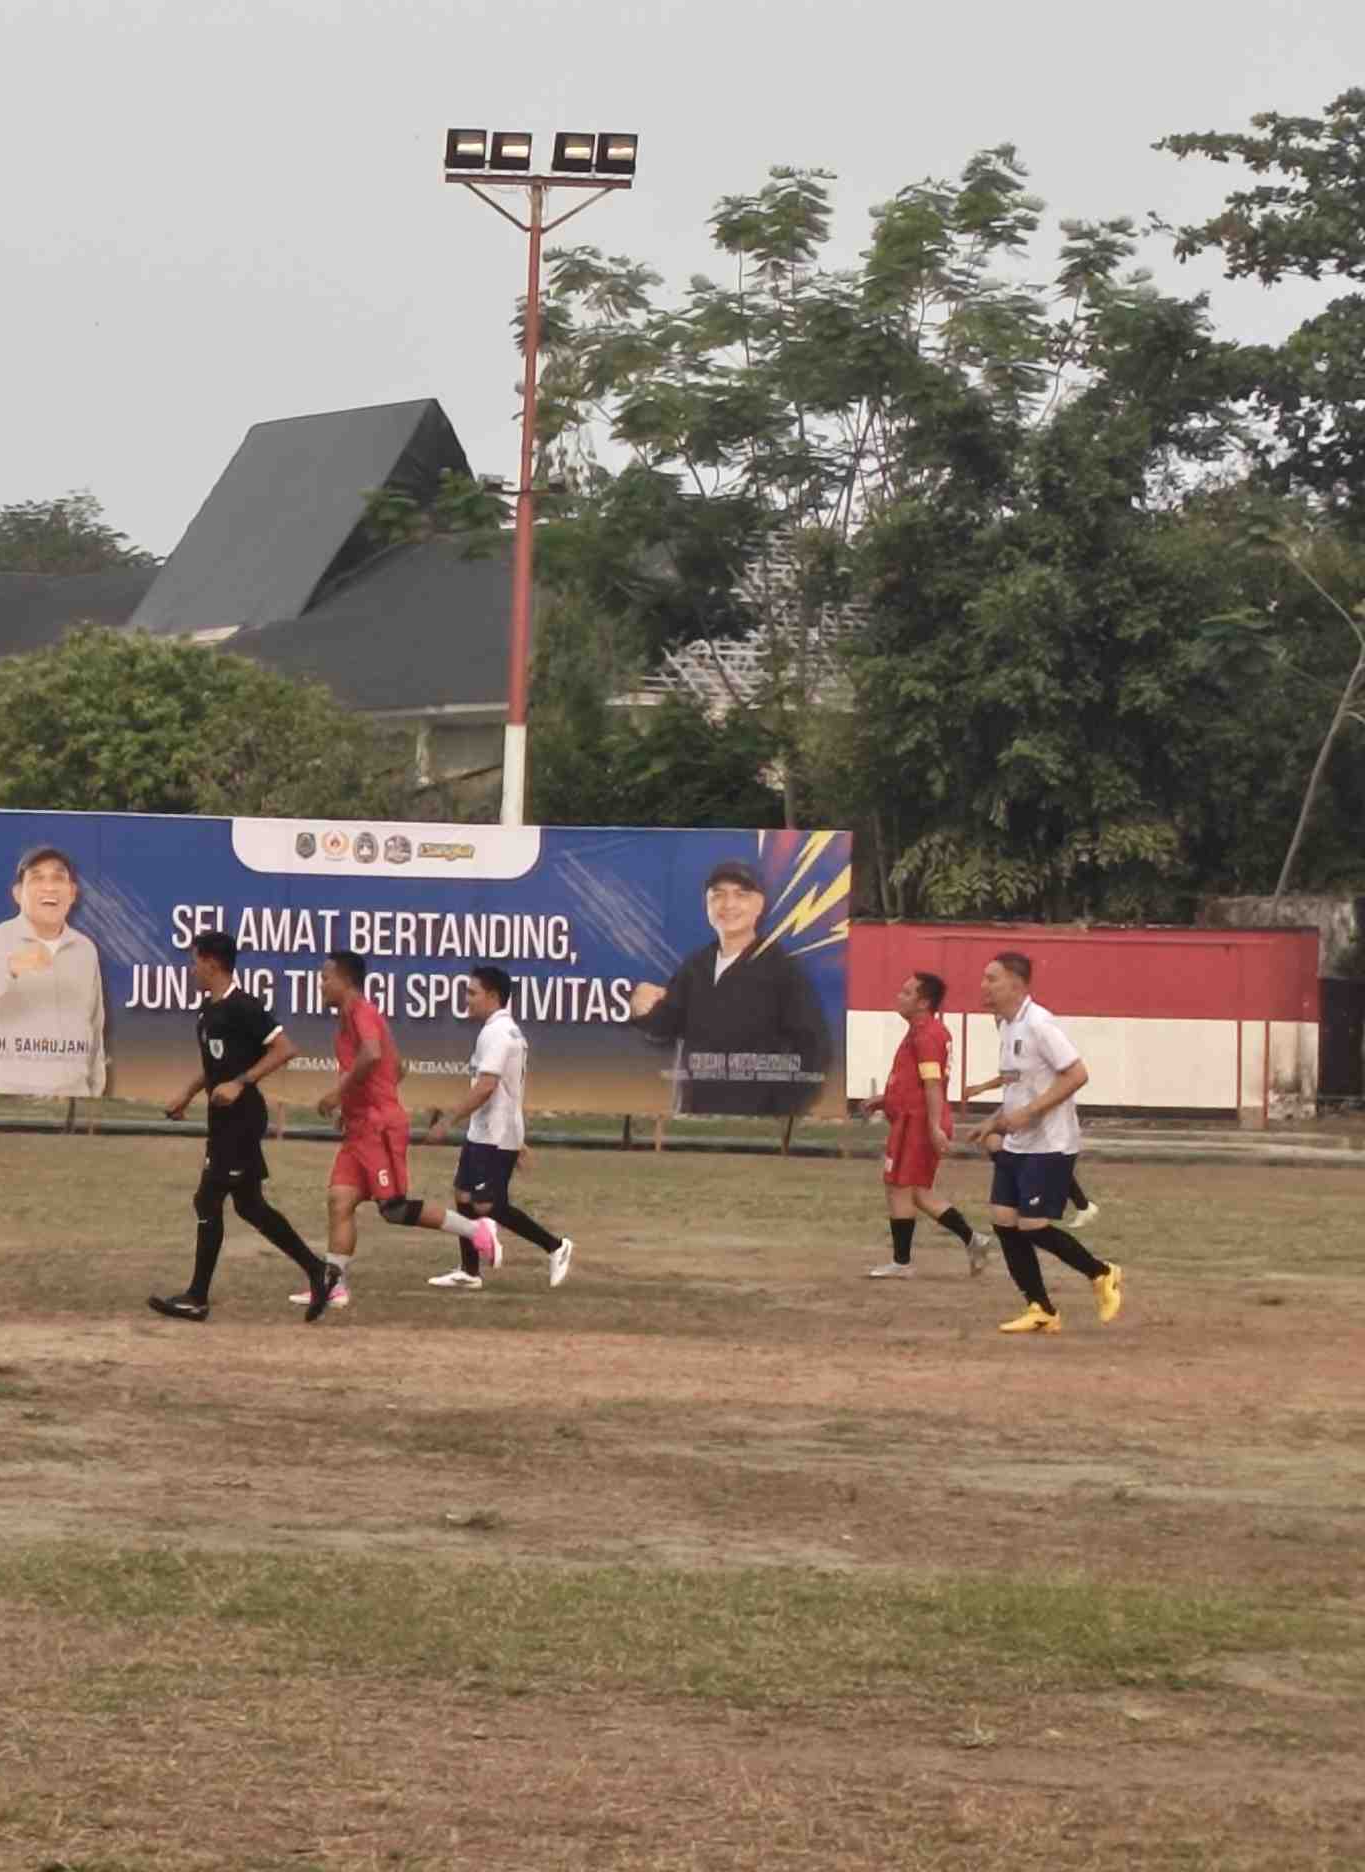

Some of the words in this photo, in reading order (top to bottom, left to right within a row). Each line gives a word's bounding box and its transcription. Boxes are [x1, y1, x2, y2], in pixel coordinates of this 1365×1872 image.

[350, 911, 577, 965] BERTANDING,
[405, 973, 631, 1022] SPOIVITAS
[378, 1169, 389, 1187] 6
